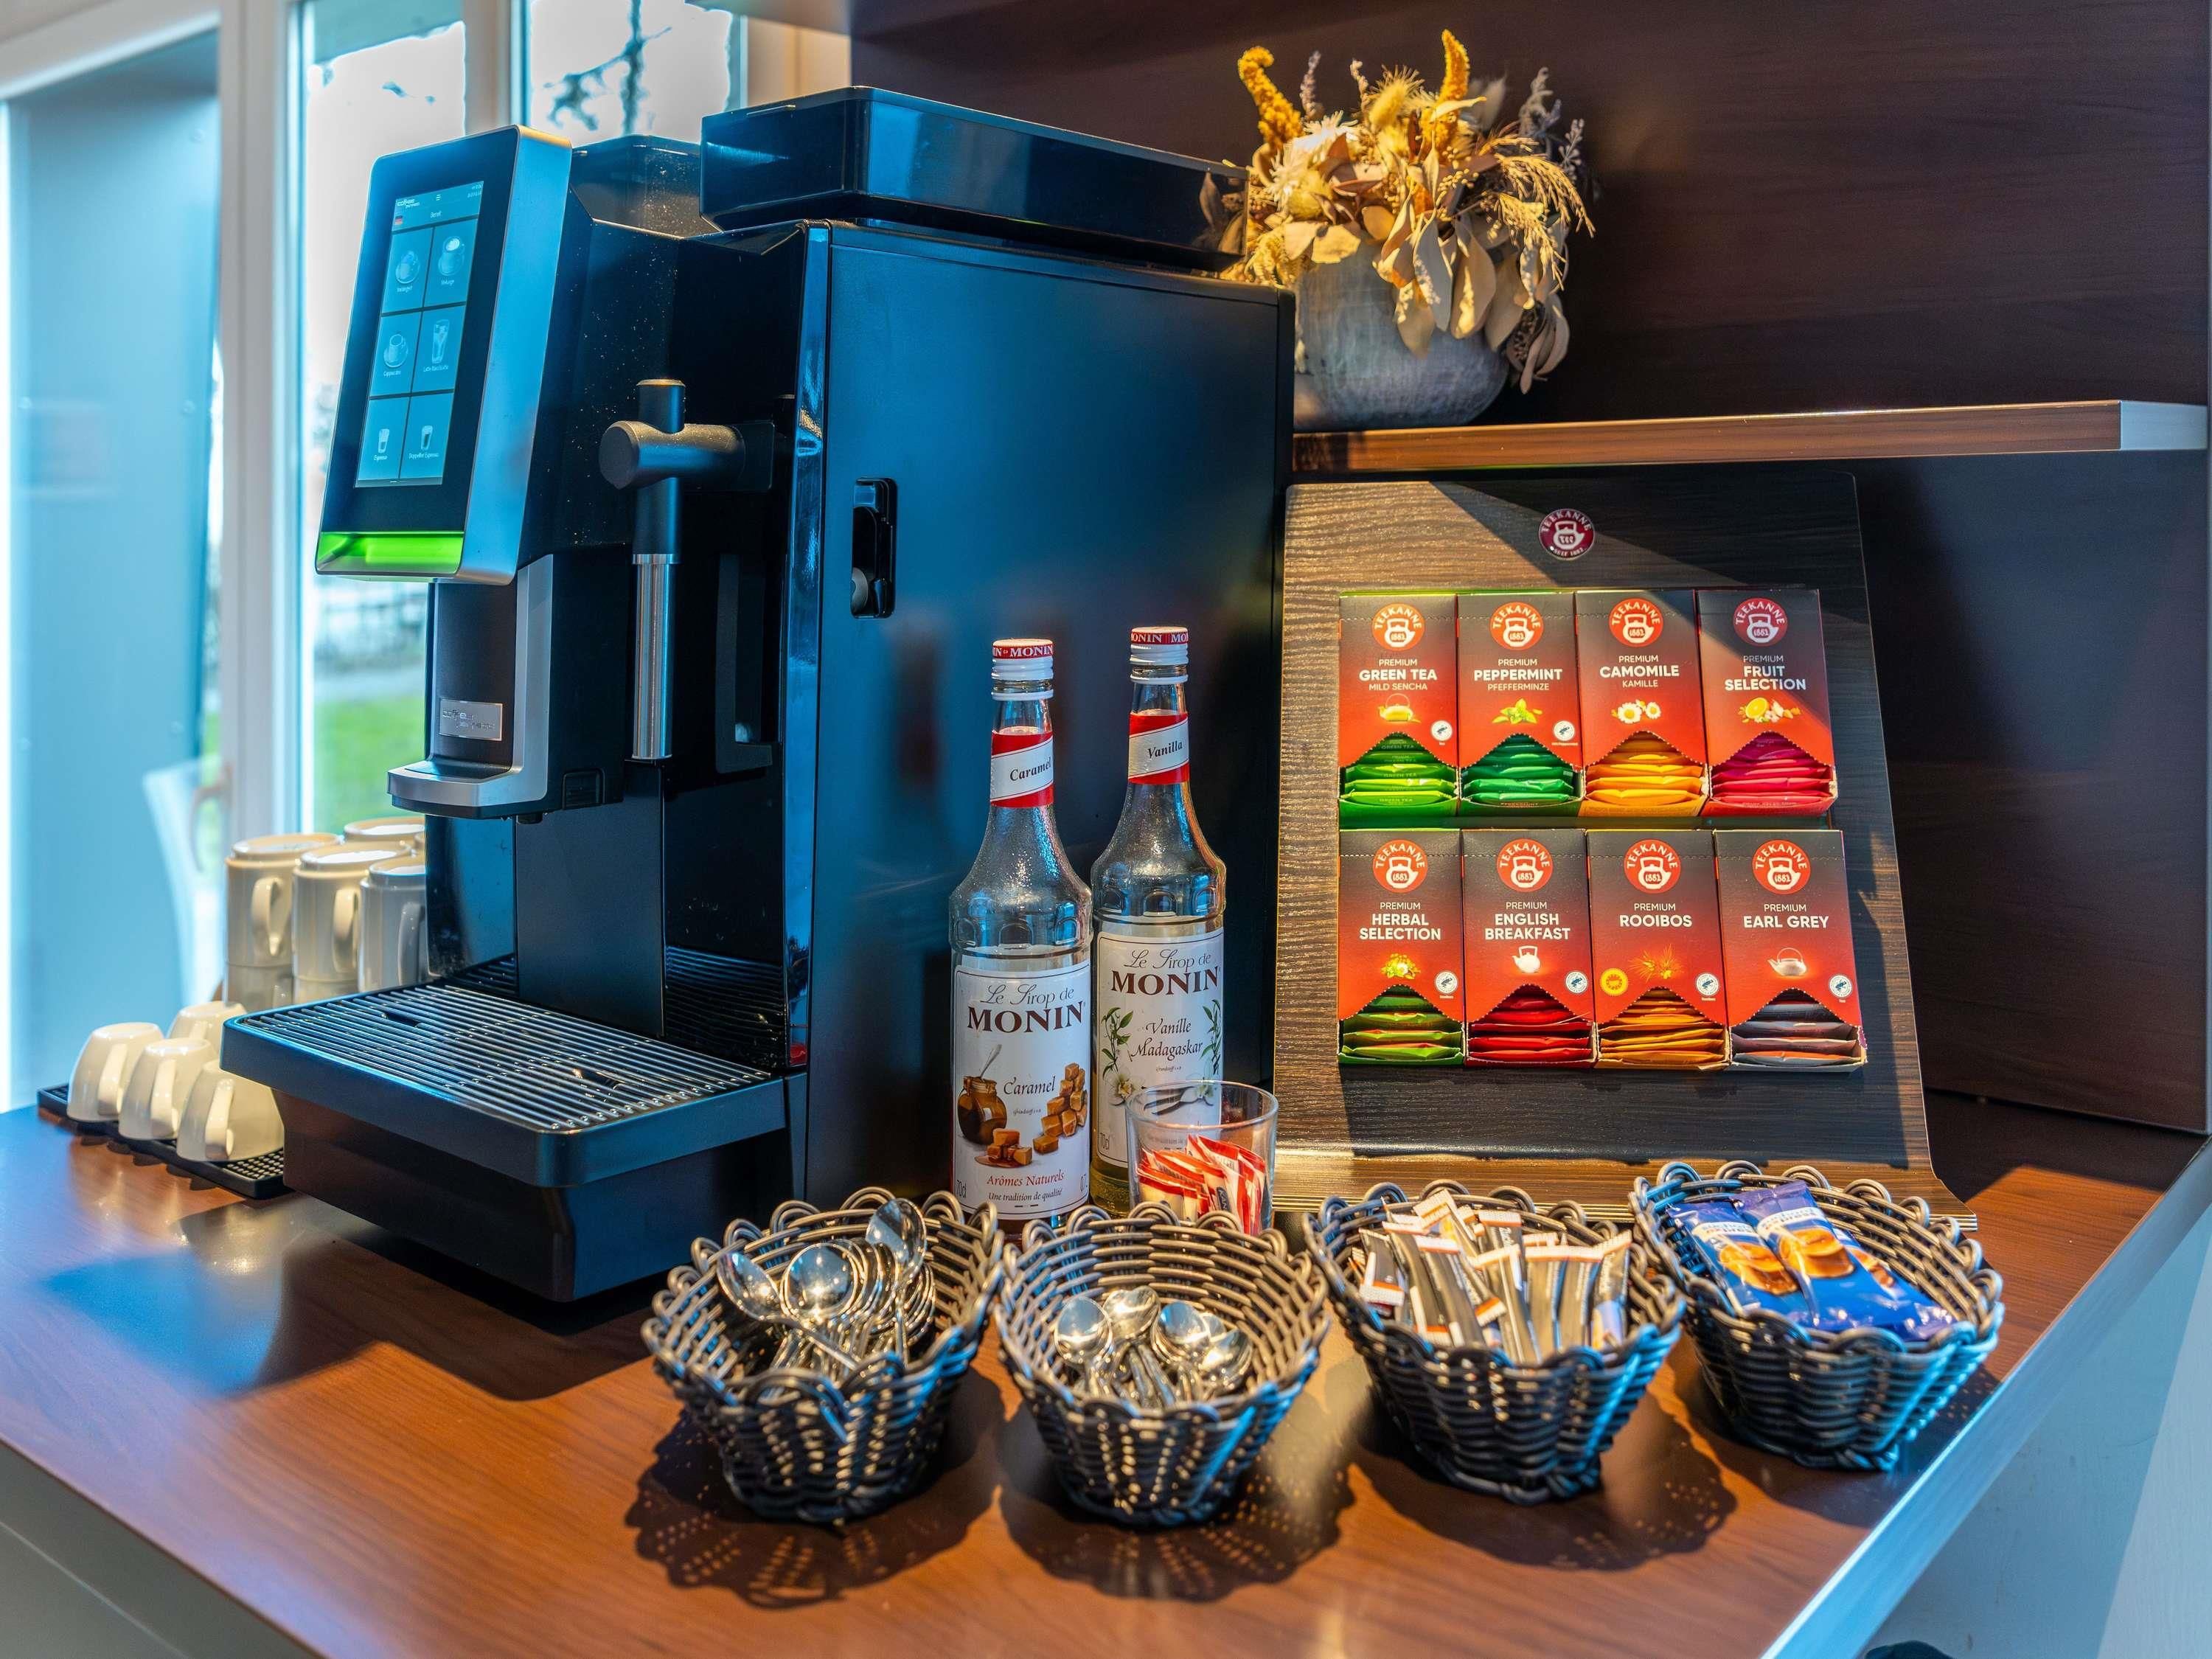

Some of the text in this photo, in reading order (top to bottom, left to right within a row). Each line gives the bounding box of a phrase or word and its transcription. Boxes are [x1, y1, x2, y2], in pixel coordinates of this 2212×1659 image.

[1541, 510, 1591, 532] TEEKANNE
[1374, 606, 1422, 630] TEEKANNE
[1492, 605, 1540, 629] TEEKANNE
[1612, 602, 1660, 625] TEEKANNE
[1735, 601, 1785, 625] TEEKANNE
[1131, 633, 1189, 643] ONIN MO
[1010, 644, 1054, 657] MONIN
[1379, 658, 1417, 667] PREMIUM
[1498, 658, 1537, 667] PREMIUM
[1618, 655, 1659, 663] PREMIUM
[1743, 655, 1784, 663] PREMIUM
[1359, 669, 1438, 681] GREEN TEA
[1474, 669, 1562, 681] PEPPERMINT
[1599, 665, 1680, 678] CAMOMILE
[1744, 665, 1785, 678] FRUIT
[1368, 682, 1427, 691] MILD SENCHA
[1487, 683, 1550, 691] PFEFFERMINZE
[1622, 680, 1658, 688] KAMILLE
[1725, 678, 1806, 691] SELECTION
[1147, 740, 1183, 759] Vanilla
[1009, 757, 1052, 782] Caramel
[1375, 843, 1425, 869] TEEKANNE
[1500, 843, 1550, 868] TEEKANNE
[1627, 843, 1677, 869] TEEKANNE
[1756, 844, 1807, 869] TEEKANNE
[1380, 902, 1421, 910] PREMIUM
[1506, 901, 1547, 910] PREMIUM
[1634, 903, 1676, 911] PREMIUM
[1764, 904, 1806, 912] PREMIUM
[1372, 914, 1429, 926] HERBAL
[1495, 914, 1559, 925] ENGLISH
[1619, 914, 1693, 928] ROOIBOS
[1743, 915, 1829, 929] EARL GREY
[1360, 928, 1441, 940] SELECTION
[1485, 928, 1571, 940] BREAKFAST
[1124, 948, 1211, 972] Le Sirop de
[1111, 966, 1219, 995] MONIN
[980, 984, 1074, 1008] Le Sirop de
[967, 1001, 1083, 1033] MONIN
[1145, 1018, 1192, 1034] Vanille
[1130, 1037, 1203, 1061] Madagaskar
[1004, 1076, 1056, 1095] Caramel
[987, 1174, 1023, 1186] Arômes
[1026, 1169, 1065, 1186] Naturels
[988, 1189, 1062, 1201] Une tradition de qualité
